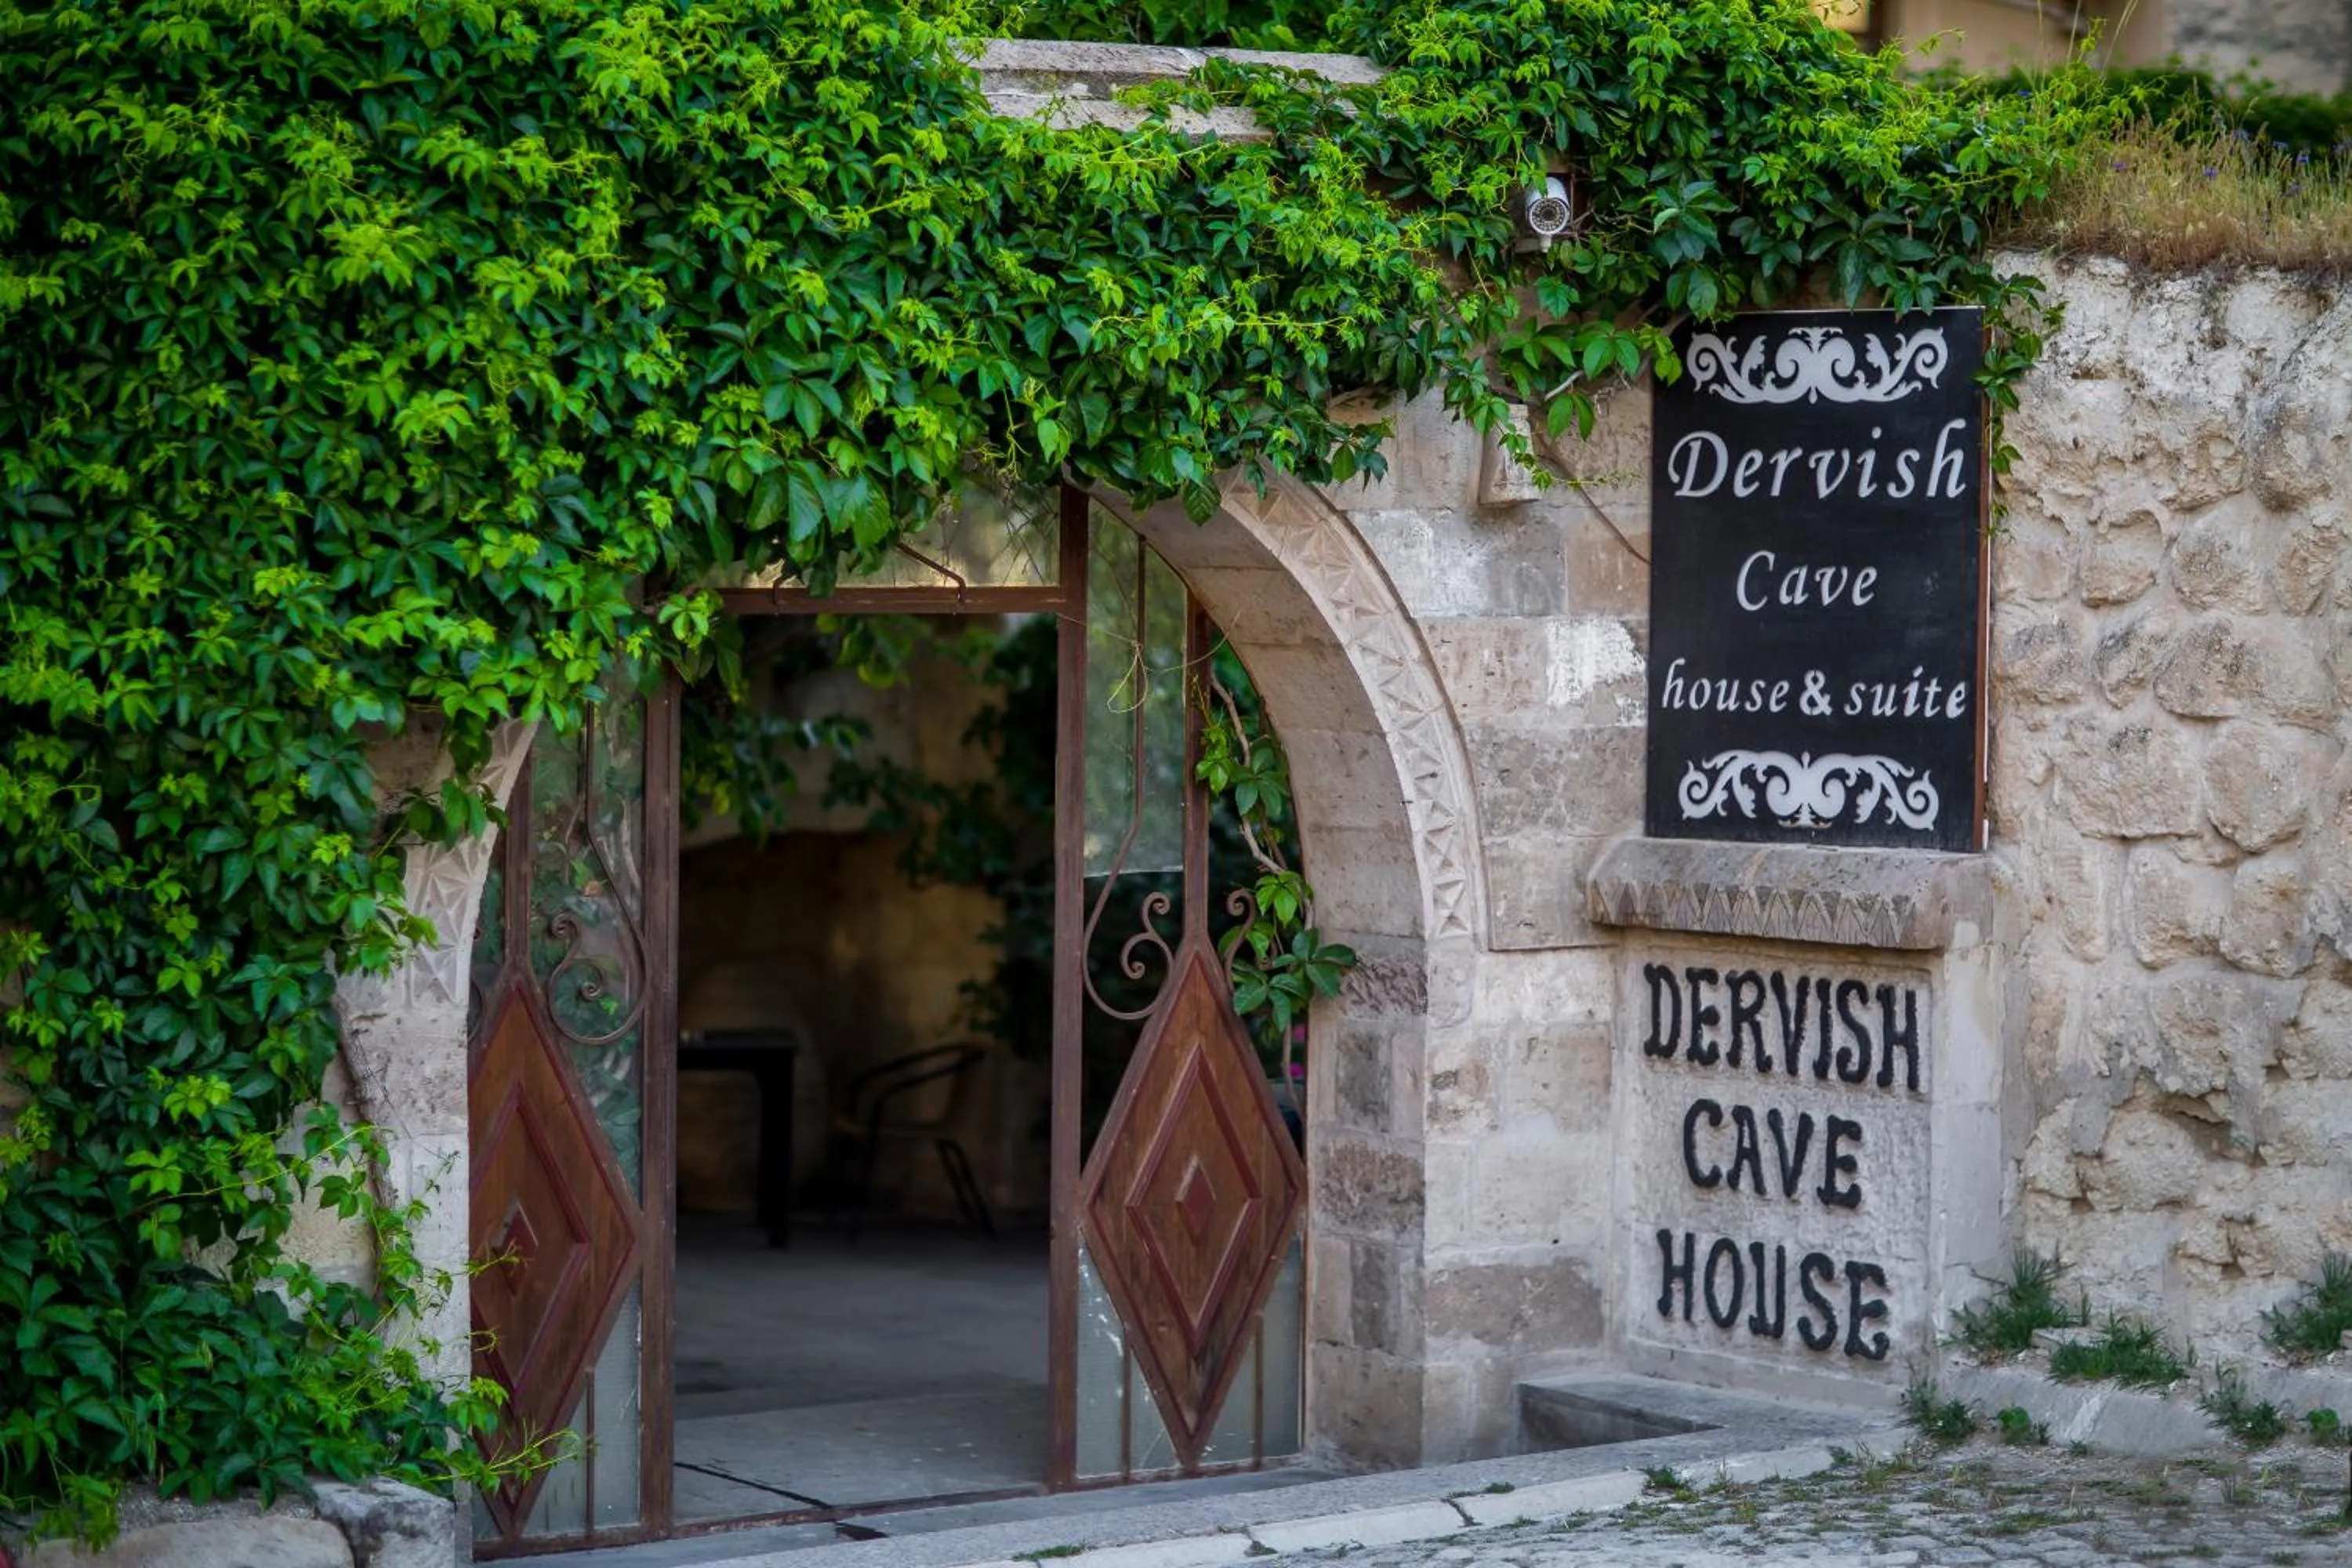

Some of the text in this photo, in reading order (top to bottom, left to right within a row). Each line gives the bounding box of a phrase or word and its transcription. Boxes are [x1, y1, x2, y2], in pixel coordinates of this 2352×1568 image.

[1668, 418, 1967, 500] Dervish
[1737, 550, 1878, 612] Cave
[1661, 658, 1790, 713] house
[1843, 665, 1966, 720] suite
[1643, 962, 1921, 1091] DERVISH
[1682, 1098, 1863, 1209] CAVE
[1656, 1228, 1890, 1361] HOUSE
